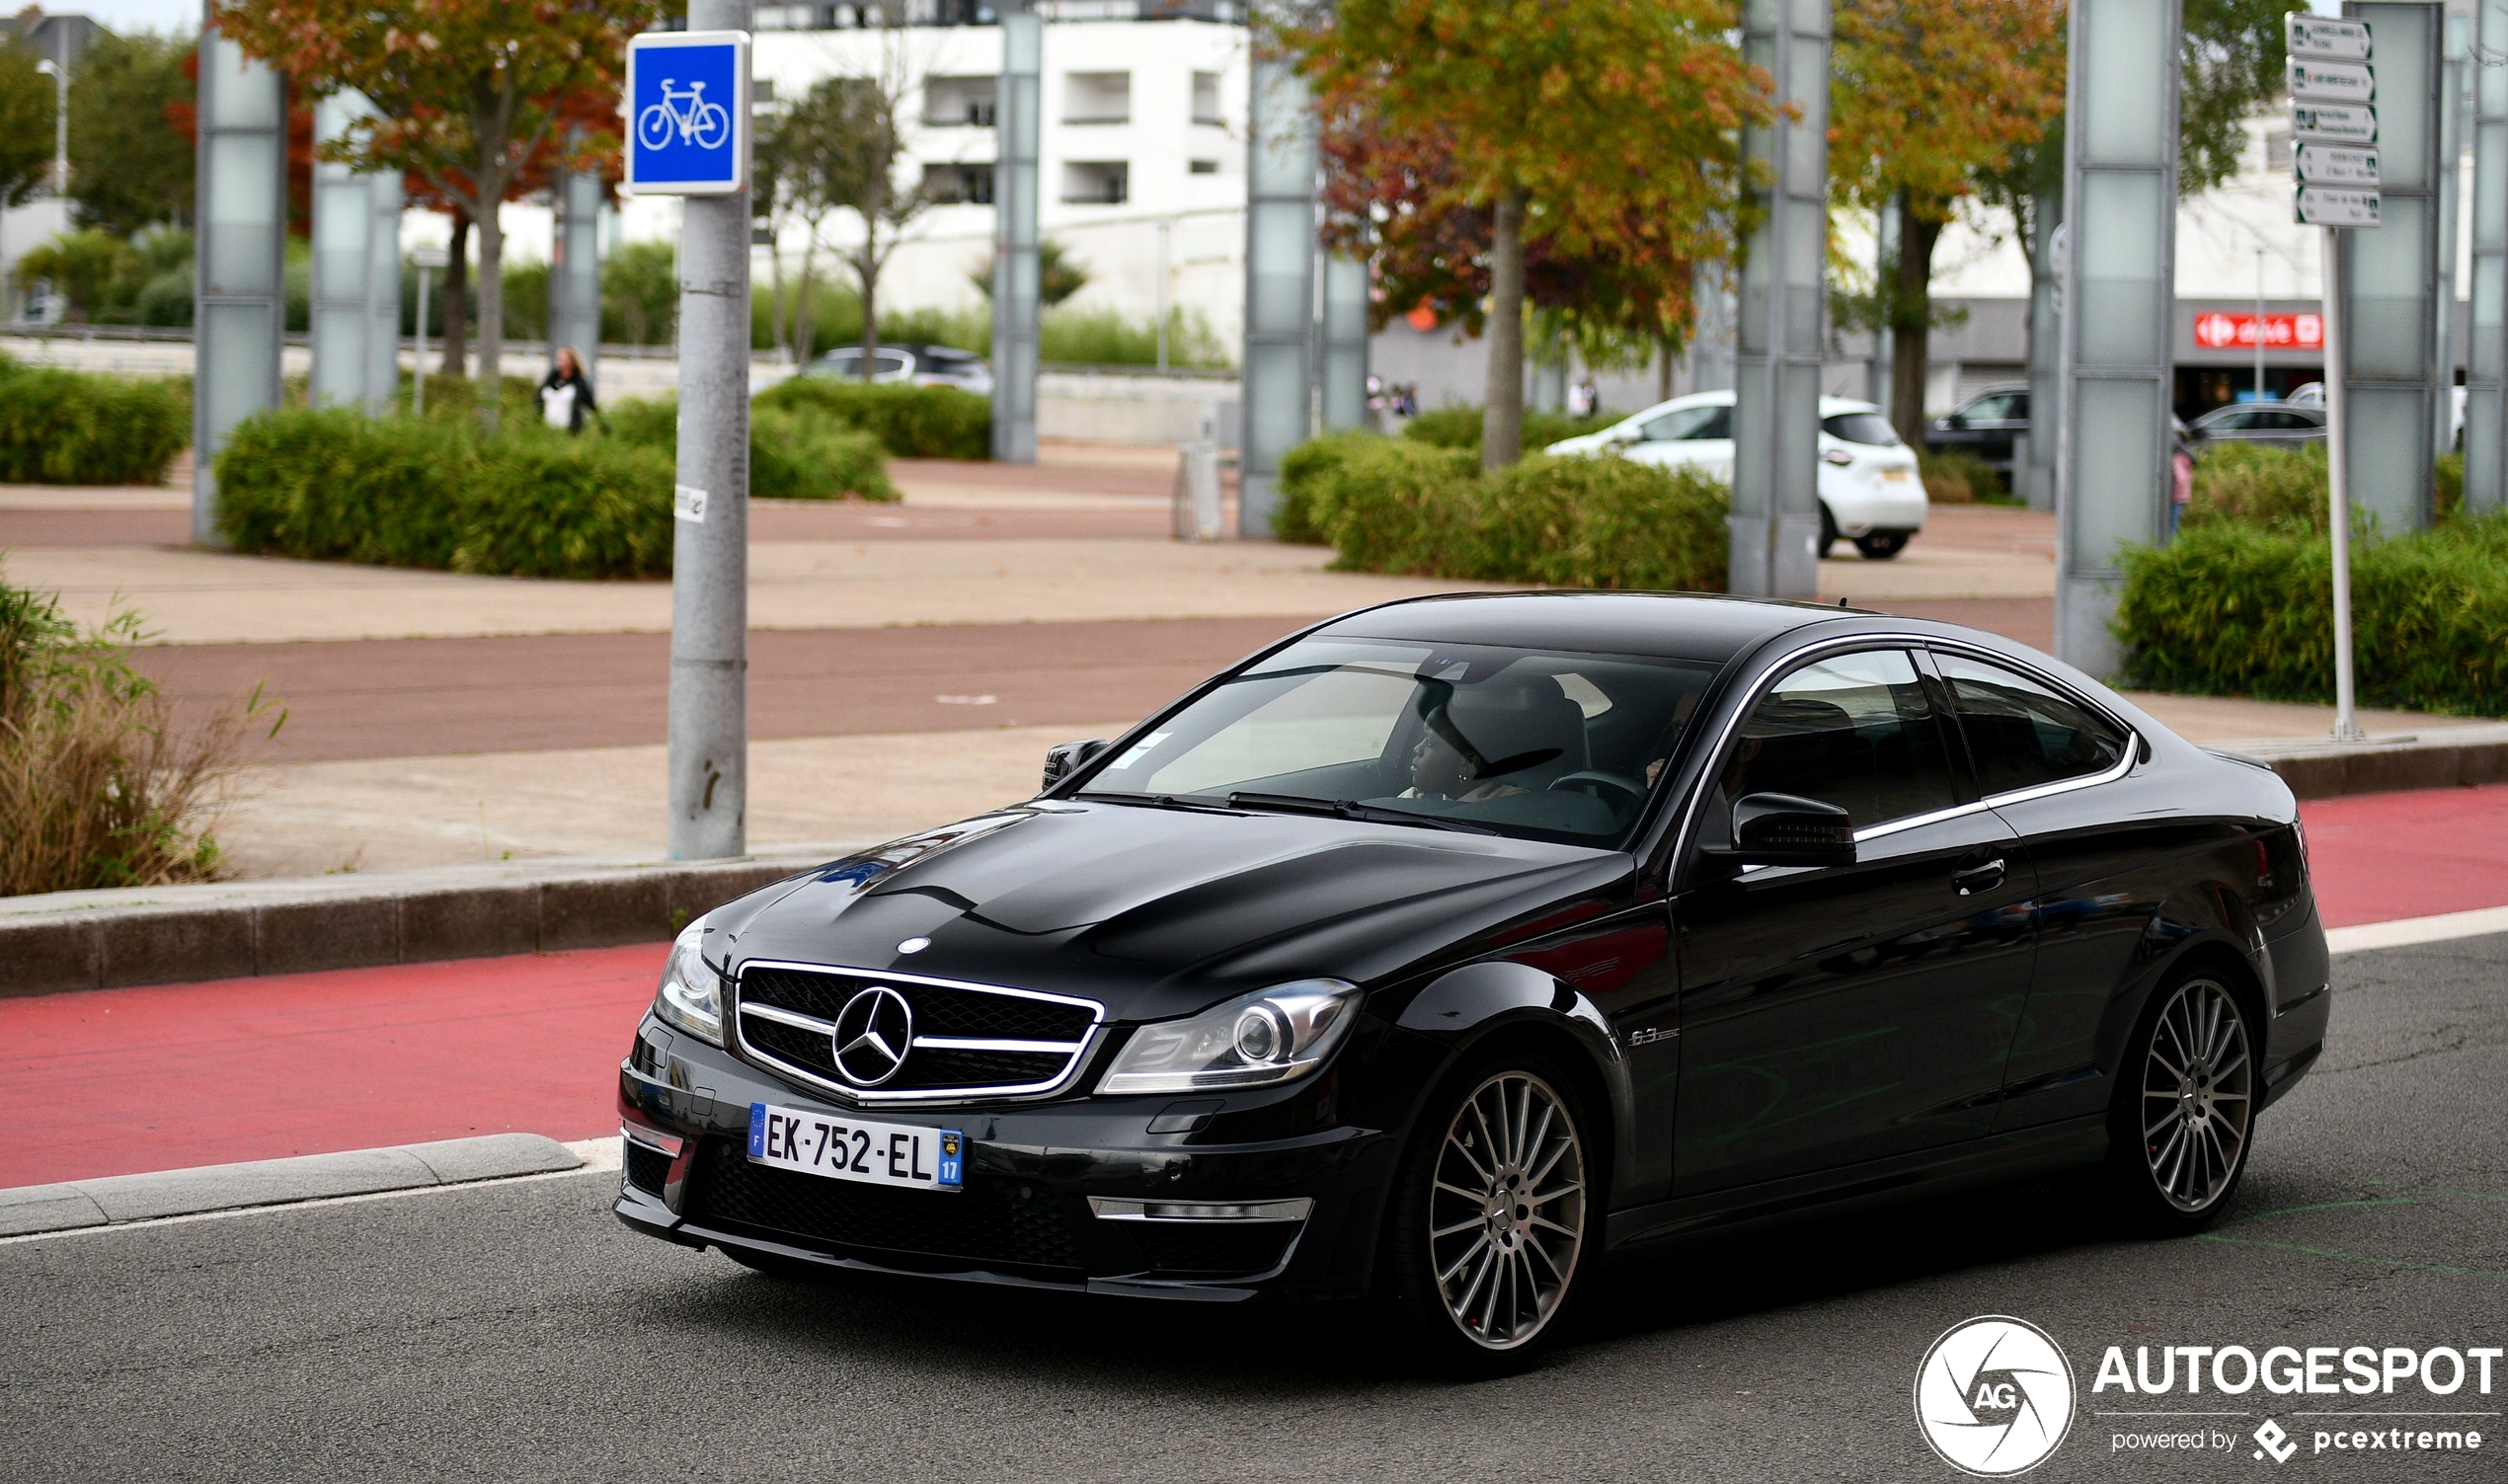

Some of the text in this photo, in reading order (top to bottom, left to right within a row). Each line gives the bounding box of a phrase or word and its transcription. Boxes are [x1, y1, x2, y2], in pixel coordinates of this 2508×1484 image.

[1631, 1028, 1657, 1047] 6.3
[753, 1135, 759, 1147] F
[767, 1114, 932, 1180] EK-752-EL
[942, 1161, 958, 1179] 17
